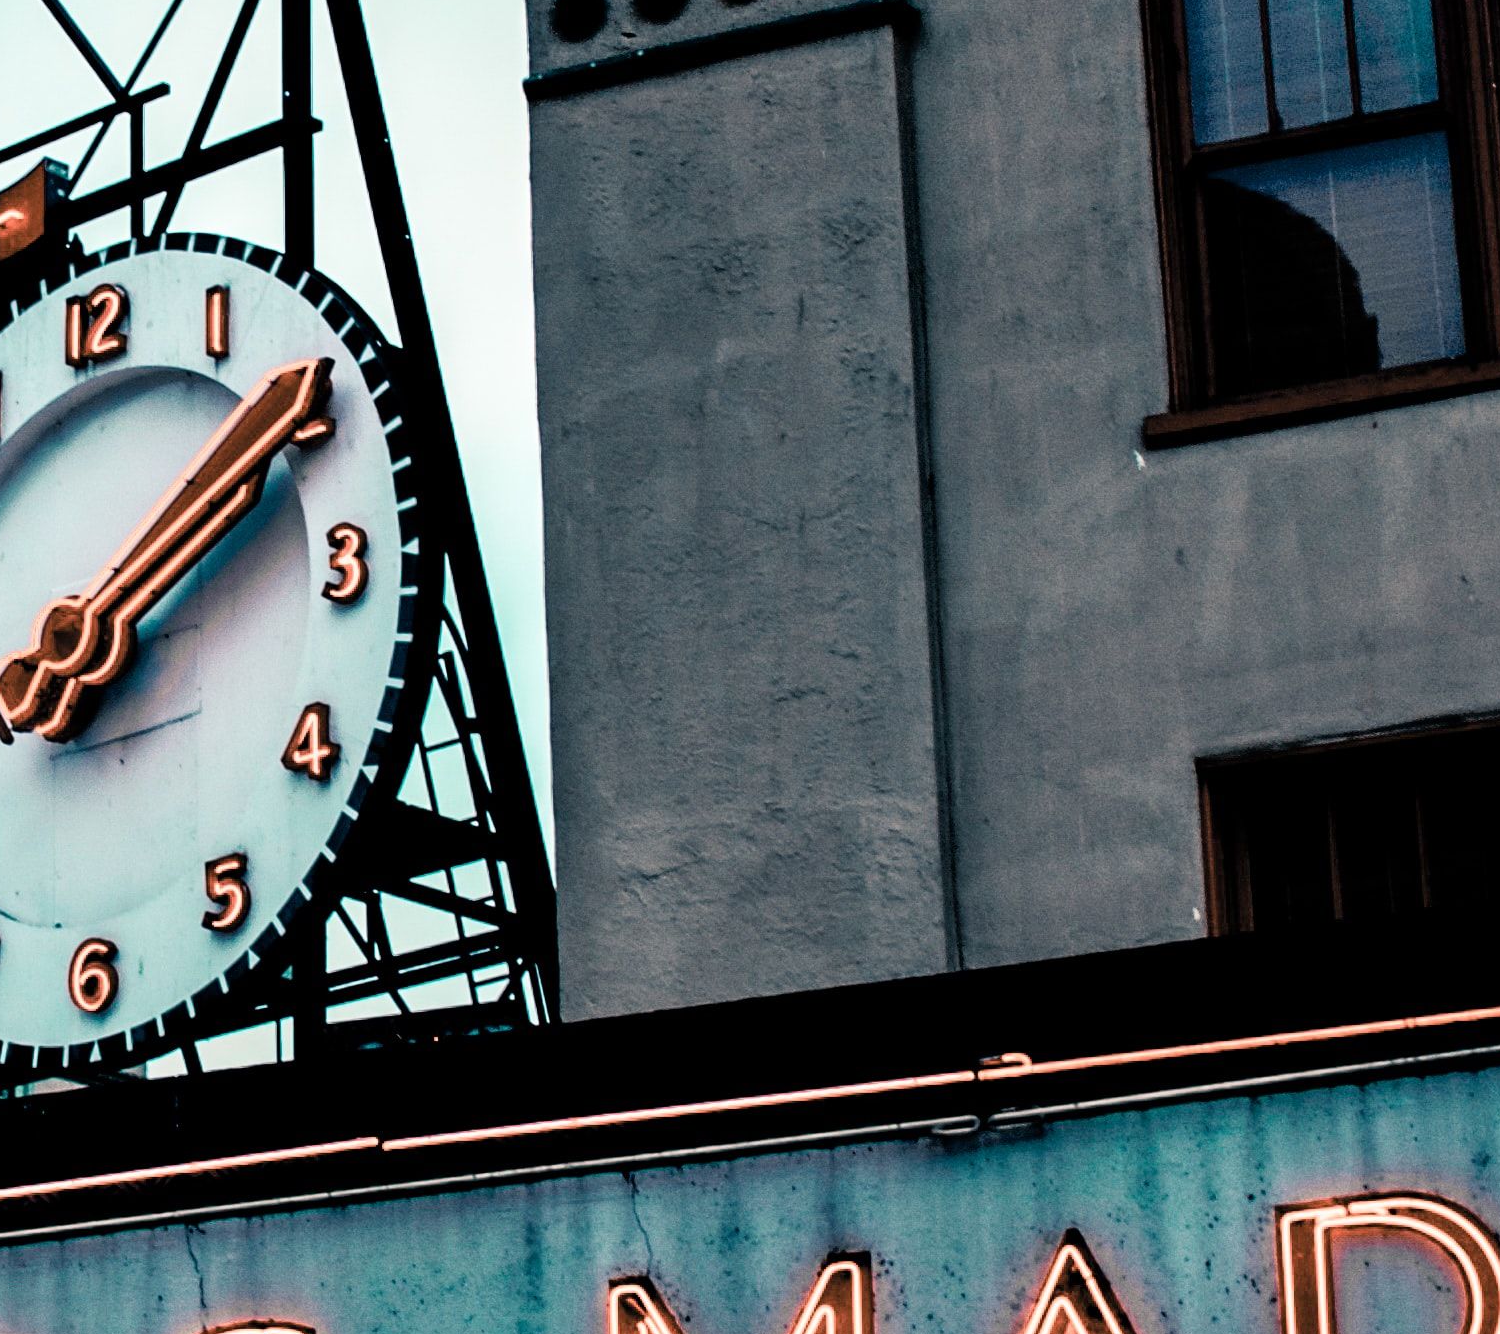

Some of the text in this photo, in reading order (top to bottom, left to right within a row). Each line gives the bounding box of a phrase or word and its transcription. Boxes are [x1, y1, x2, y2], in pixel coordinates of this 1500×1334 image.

[65, 283, 129, 367] 12
[206, 284, 232, 358] 1
[322, 522, 370, 604] 3
[280, 702, 340, 781] 4
[201, 852, 251, 933] 5
[67, 938, 120, 1012] 6
